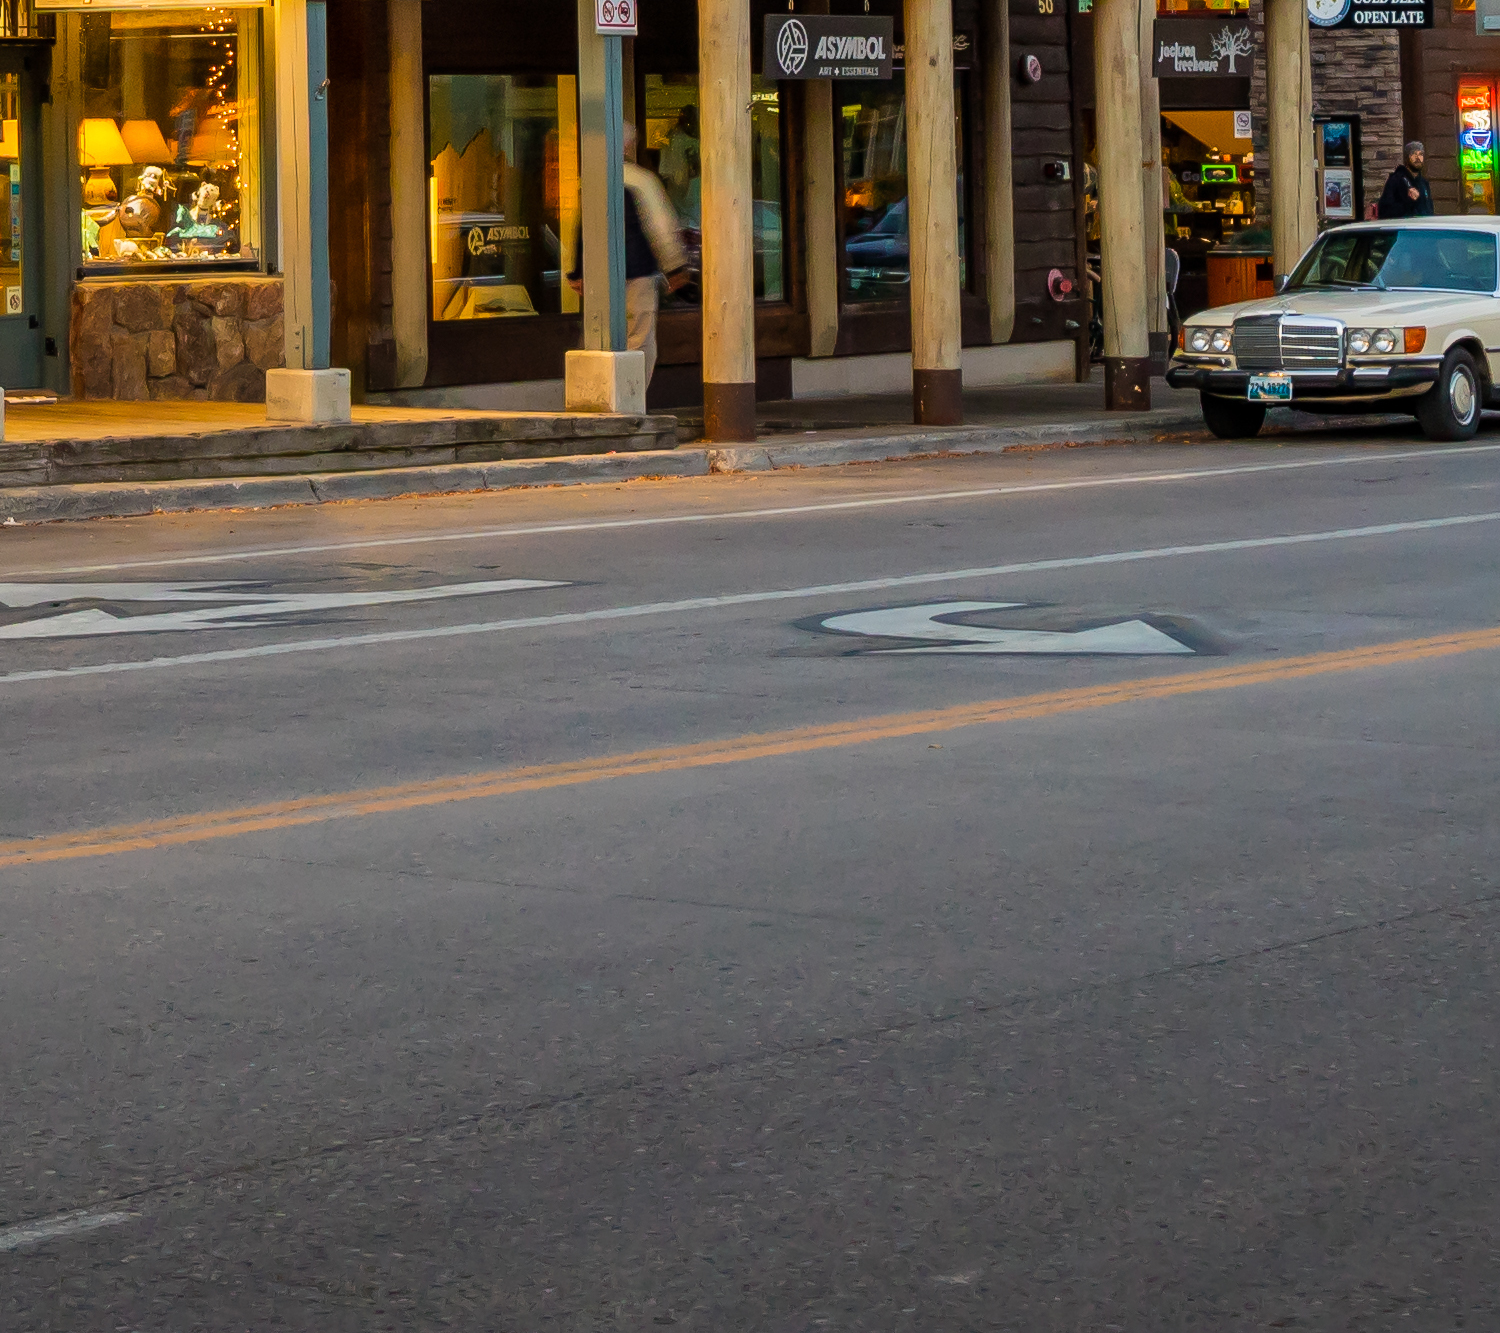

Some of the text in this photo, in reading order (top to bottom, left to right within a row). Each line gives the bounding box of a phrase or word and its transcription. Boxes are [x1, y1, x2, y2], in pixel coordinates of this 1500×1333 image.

[1354, 10, 1425, 24] OPEN LATE
[814, 36, 886, 60] ASYMBOL
